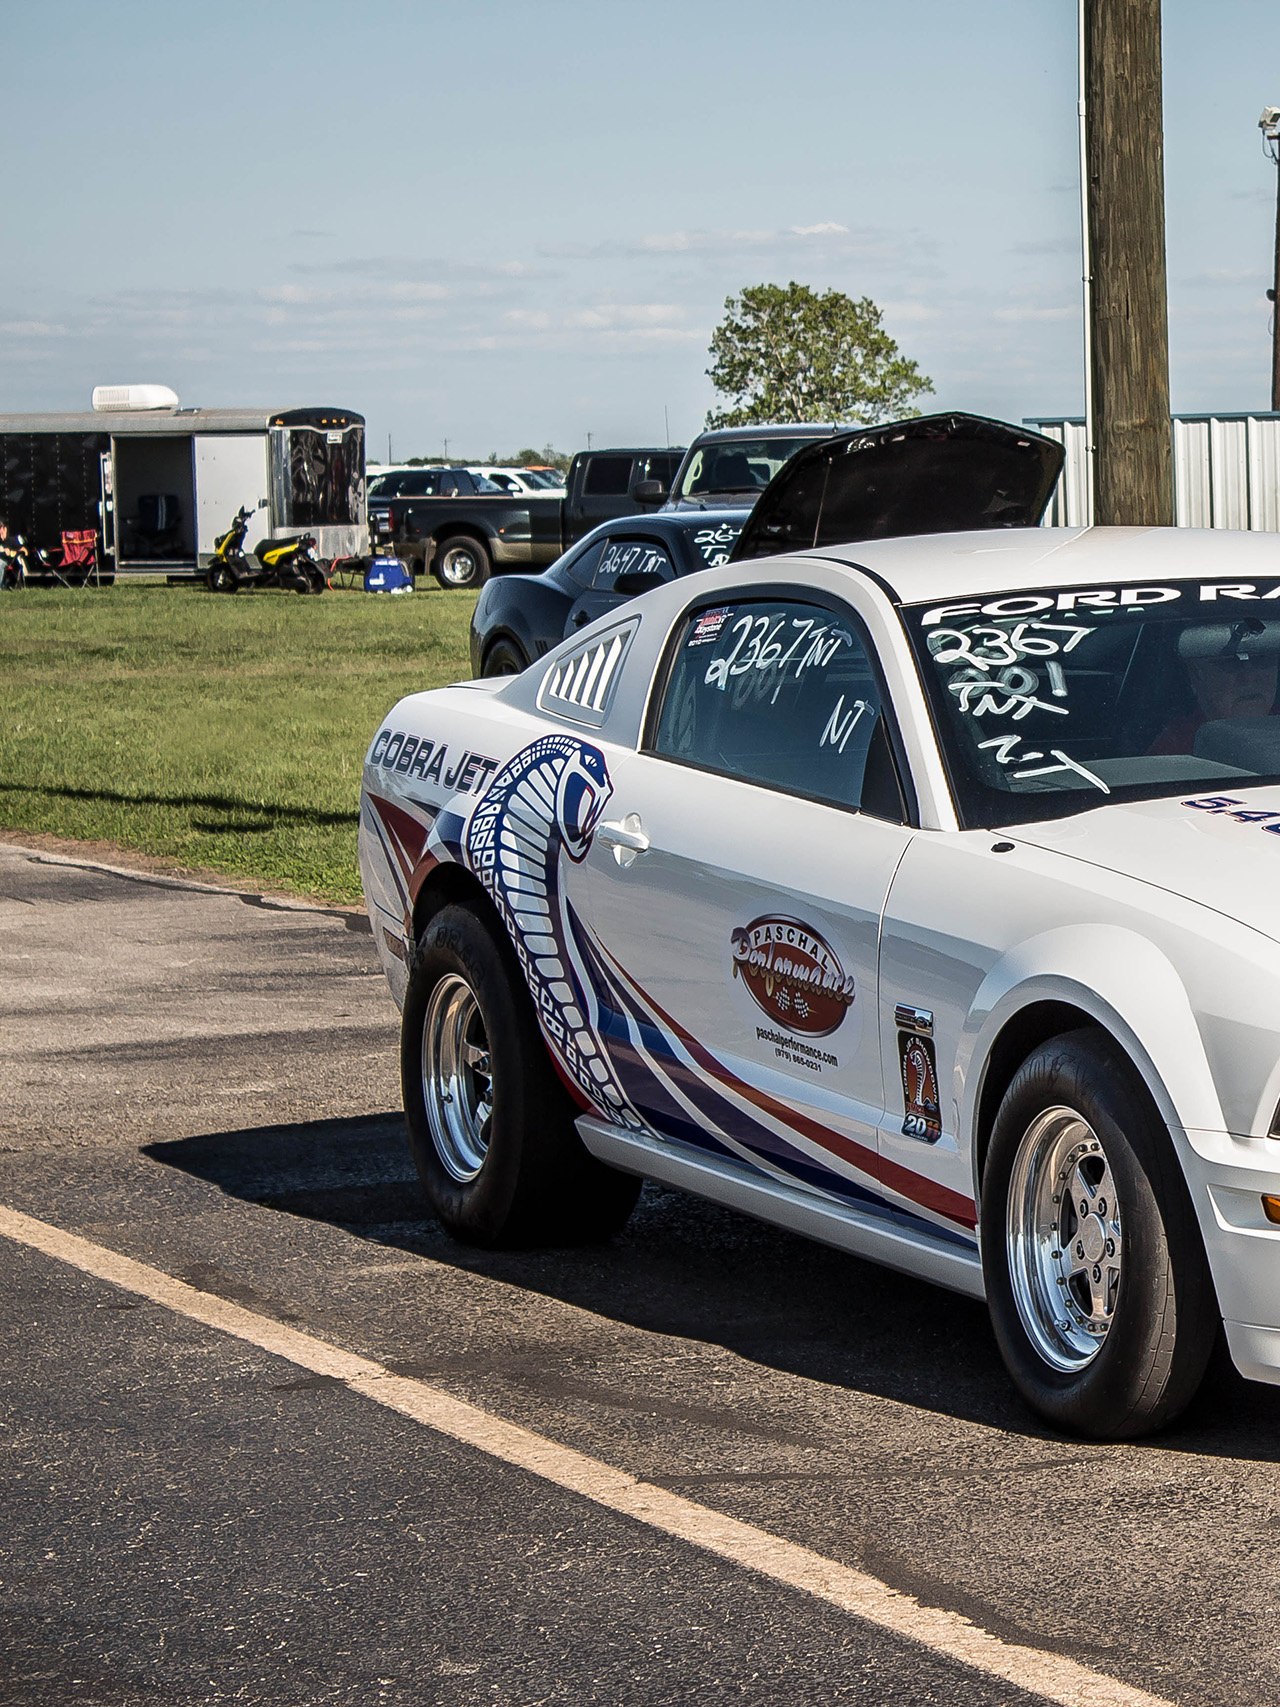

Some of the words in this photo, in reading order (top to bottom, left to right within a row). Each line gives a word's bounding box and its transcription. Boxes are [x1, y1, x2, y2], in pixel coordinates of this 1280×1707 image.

[599, 545, 641, 574] 2647
[921, 588, 1182, 626] FORD
[705, 615, 814, 687] 2367
[926, 622, 1098, 671] 2367
[371, 728, 449, 786] COBRA
[443, 750, 501, 797] JET
[753, 926, 829, 971] PASCHAL
[755, 1026, 839, 1067] paschalperformance.com
